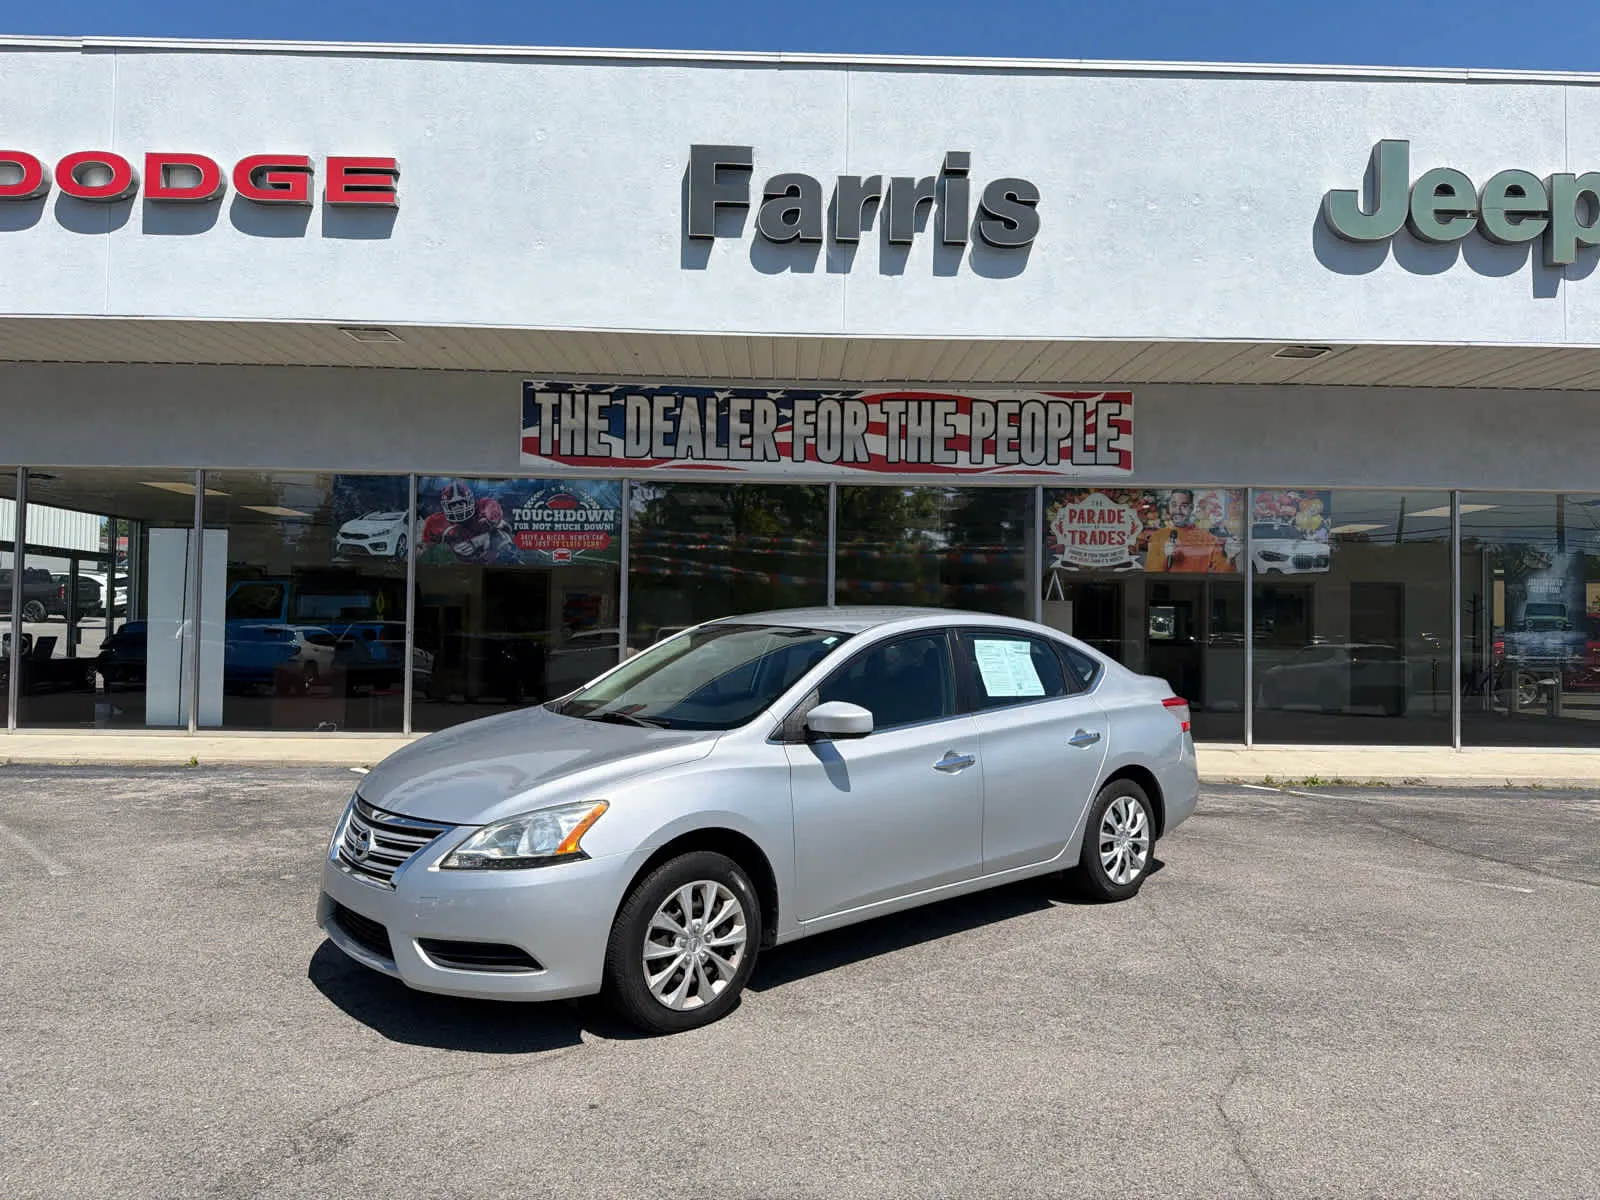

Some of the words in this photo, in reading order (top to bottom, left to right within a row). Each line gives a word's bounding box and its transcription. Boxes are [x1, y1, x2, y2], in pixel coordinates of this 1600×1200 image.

[687, 144, 1041, 246] Farris
[1324, 139, 1600, 264] Jeep
[534, 391, 612, 458] THE
[624, 394, 781, 462] DEALER
[791, 397, 871, 464] FOR
[881, 399, 958, 465] THE
[970, 399, 1121, 466] PEOPLE
[512, 508, 616, 522] TOUCHDOWN
[1068, 508, 1126, 525] PARADE
[513, 522, 529, 531] FOR
[532, 522, 550, 531] NOT
[554, 522, 581, 532] MUCH
[584, 522, 614, 531] DOWN!
[1067, 529, 1126, 546] TRADES
